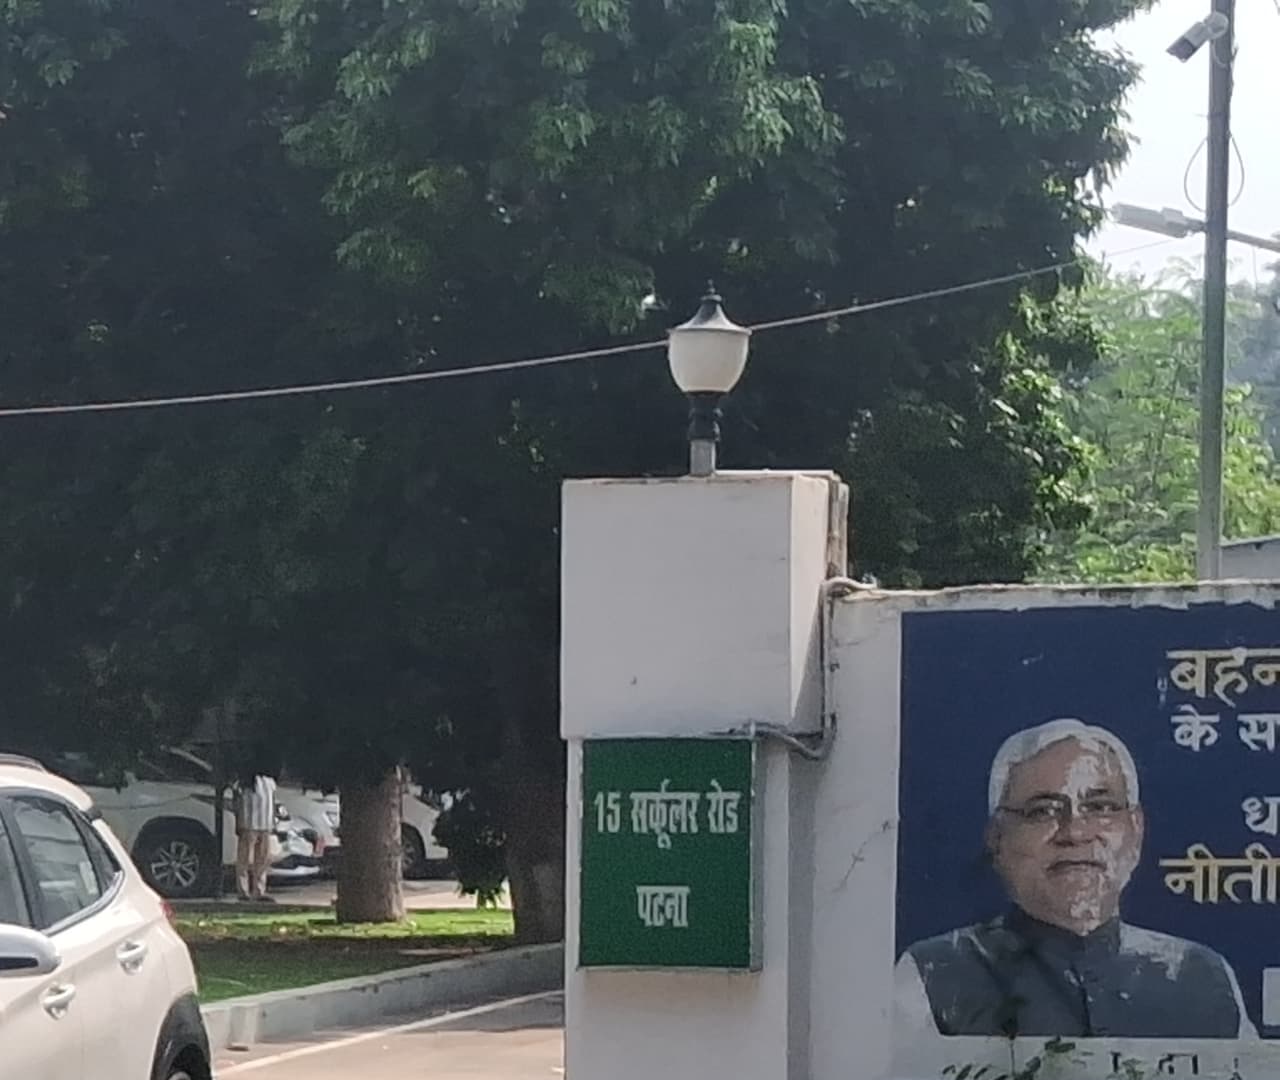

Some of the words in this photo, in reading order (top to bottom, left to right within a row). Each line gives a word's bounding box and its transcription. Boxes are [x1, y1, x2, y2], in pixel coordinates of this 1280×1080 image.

[1171, 704, 1220, 751] के
[1237, 713, 1280, 751] स
[594, 791, 621, 833] 15
[706, 778, 741, 833] रोड
[635, 885, 690, 927] पटना
